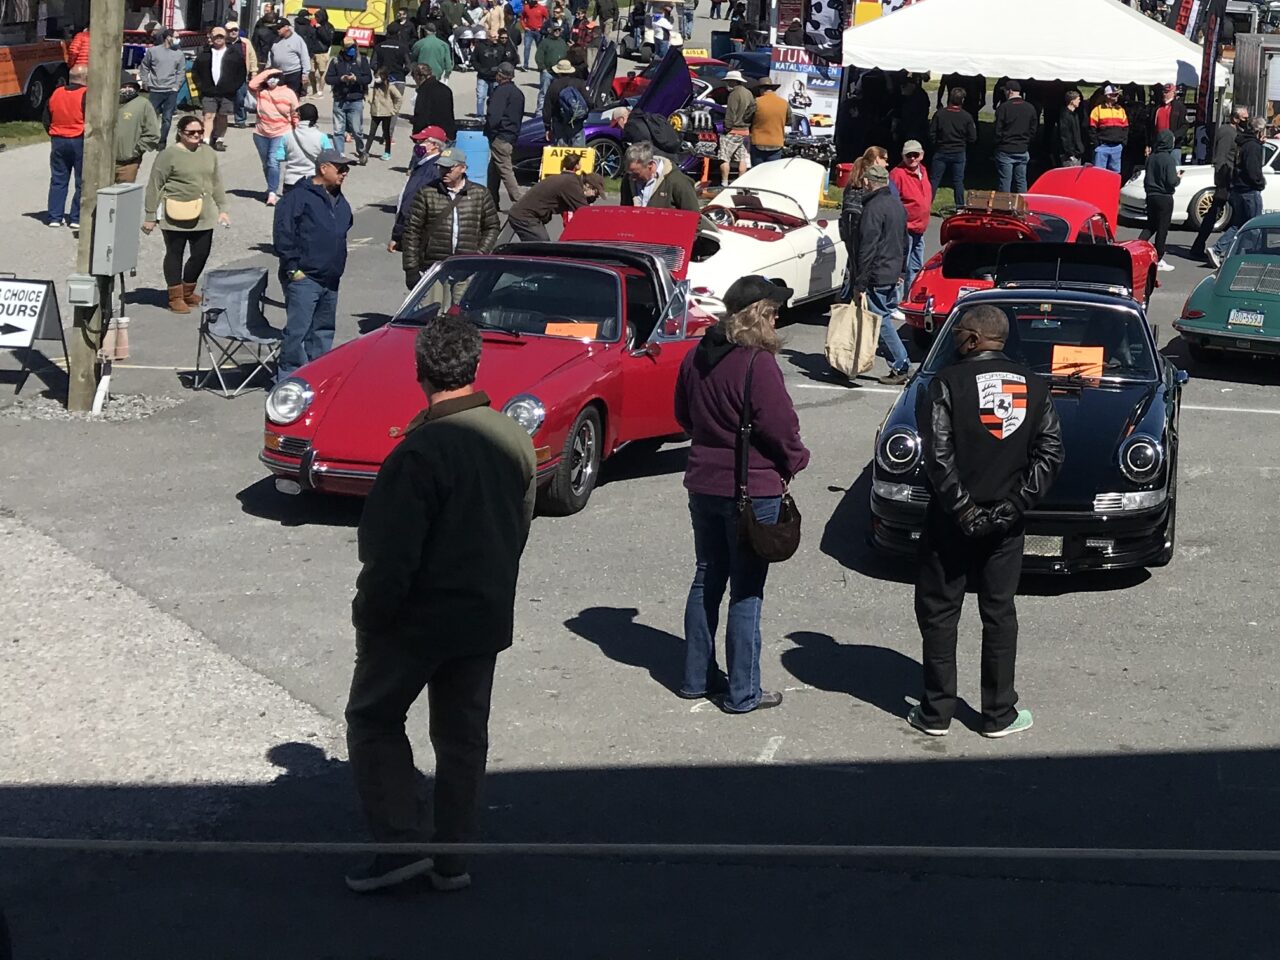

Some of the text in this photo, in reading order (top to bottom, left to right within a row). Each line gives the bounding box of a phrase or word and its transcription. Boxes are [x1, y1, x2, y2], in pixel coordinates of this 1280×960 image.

[347, 28, 370, 38] EXIT
[778, 47, 838, 67] TUNIN
[775, 62, 838, 76] KATALYSATEN
[811, 78, 836, 87] HJS
[550, 149, 587, 159] AISLE
[3, 288, 43, 303] CHOICE
[977, 373, 1023, 381] PORSCHE
